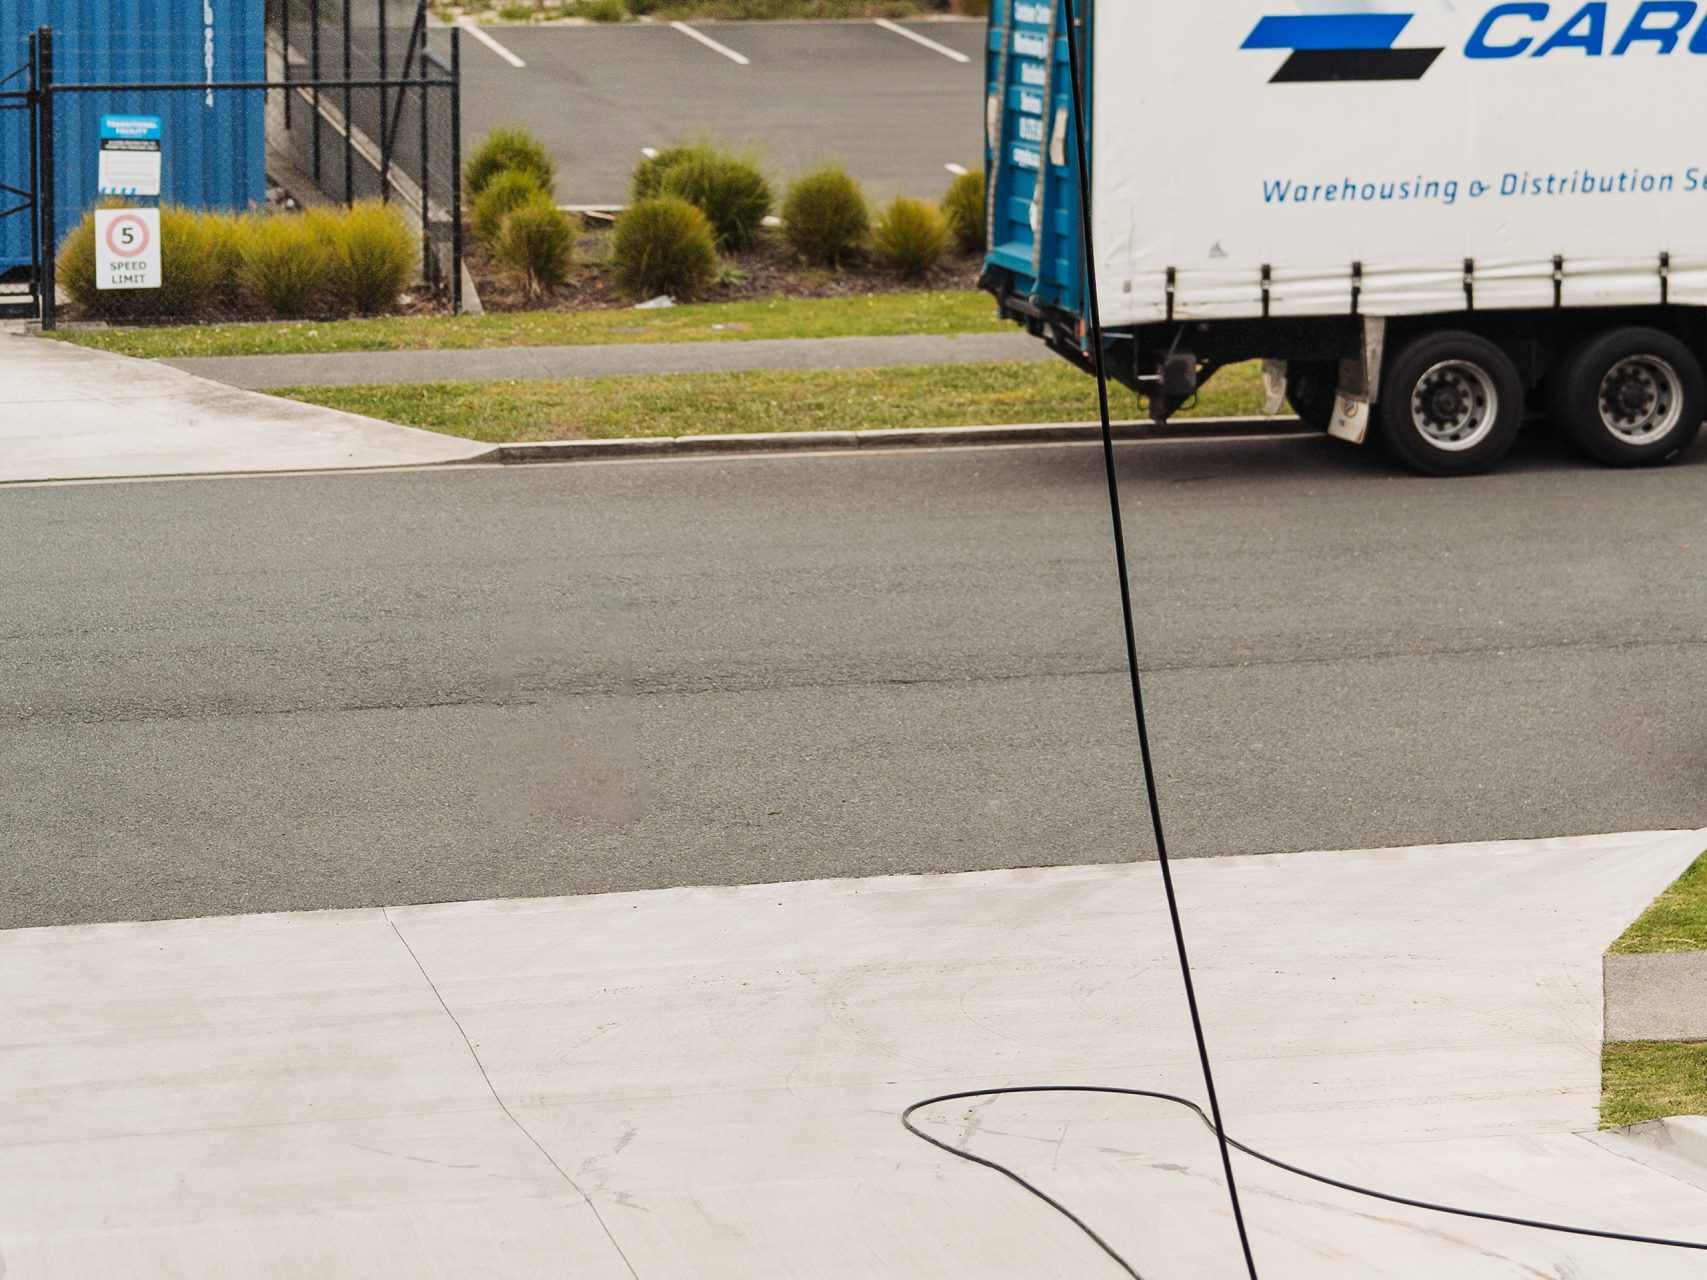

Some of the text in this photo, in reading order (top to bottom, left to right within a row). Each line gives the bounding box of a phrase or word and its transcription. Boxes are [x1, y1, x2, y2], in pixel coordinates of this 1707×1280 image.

[1463, 0, 1707, 60] CAR
[1263, 175, 1458, 205] Warehousing
[1468, 180, 1490, 198] &
[1500, 168, 1674, 196] Distribution
[121, 227, 135, 245] 5
[110, 261, 147, 272] SPEED
[112, 274, 146, 285] LIMIT
